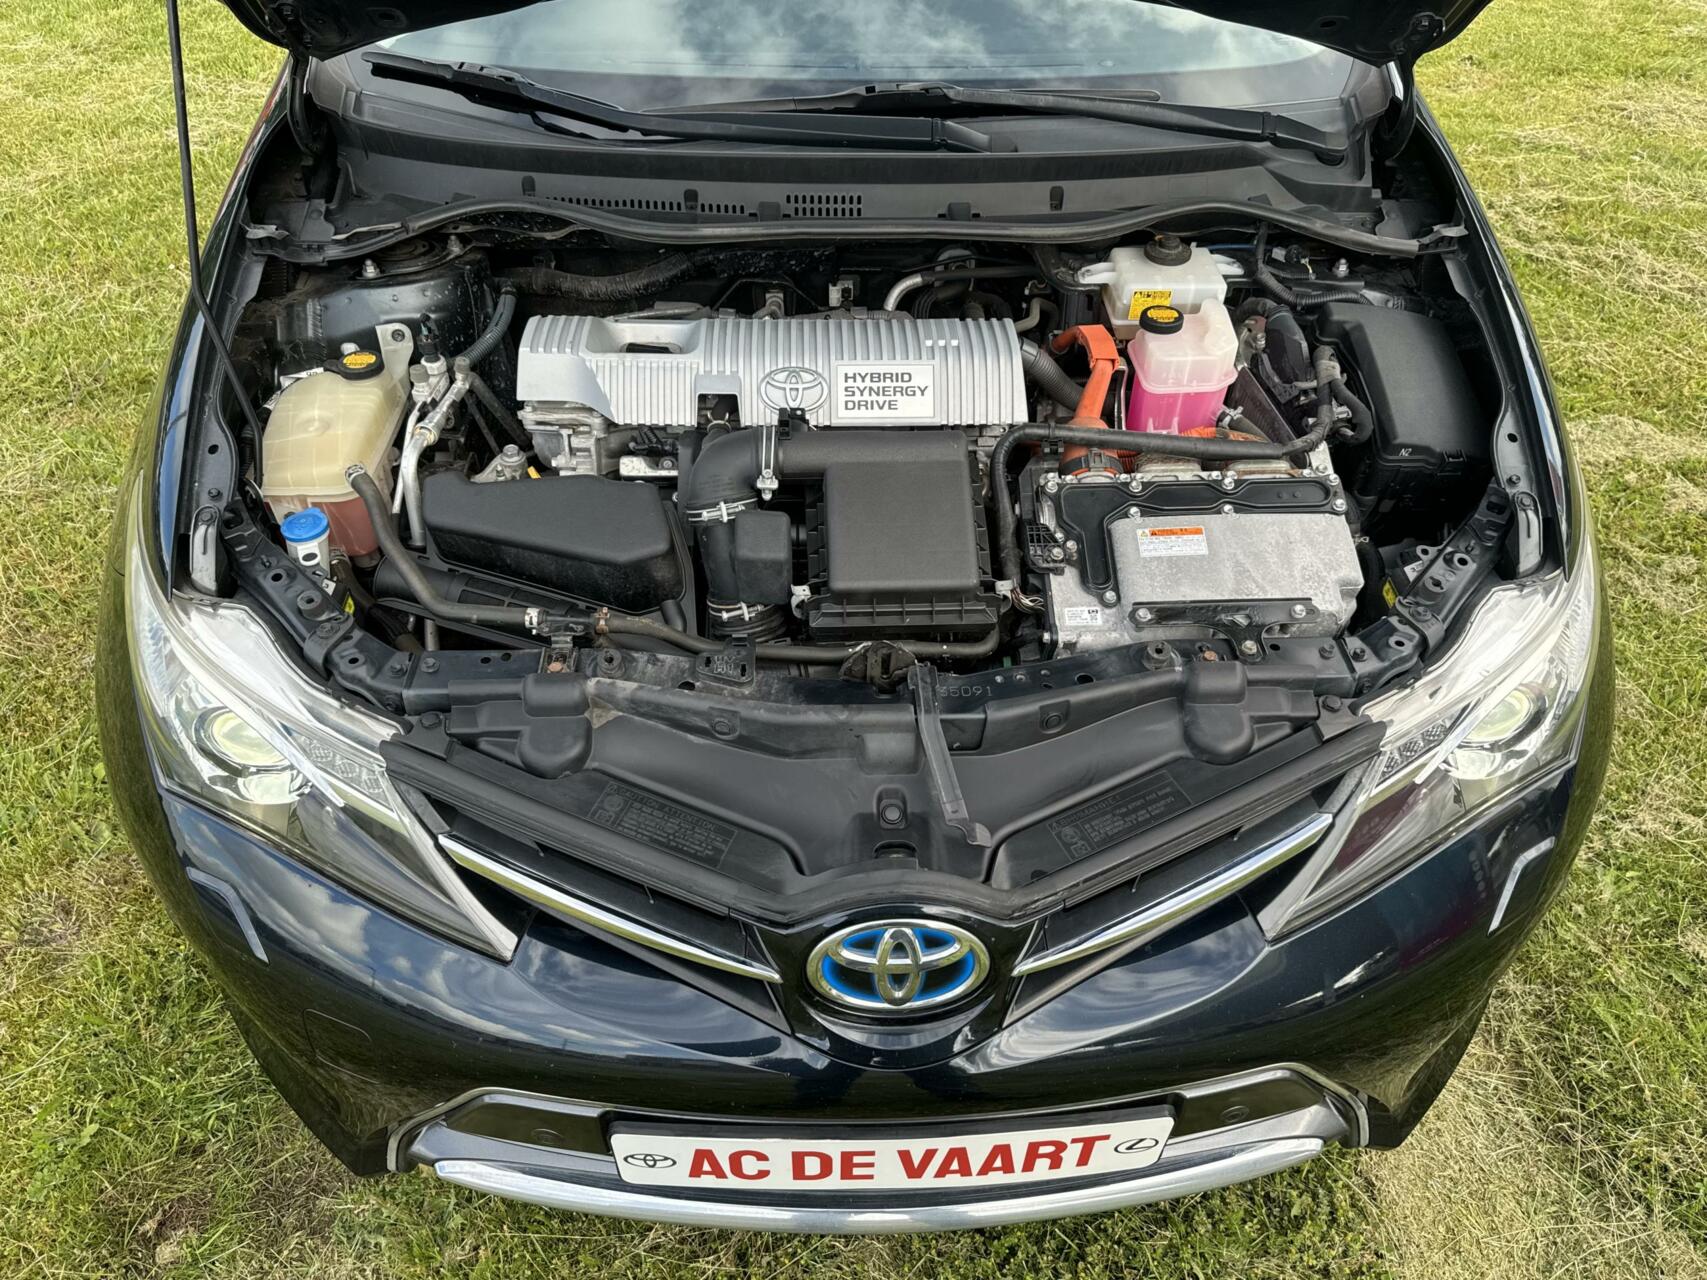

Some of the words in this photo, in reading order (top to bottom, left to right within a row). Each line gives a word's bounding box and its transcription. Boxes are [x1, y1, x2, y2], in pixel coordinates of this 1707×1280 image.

[844, 372, 912, 383] HYBRID
[844, 386, 928, 397] SYNERGY
[844, 400, 898, 411] DRIVE
[620, 788, 659, 809] CAUTION
[664, 806, 716, 831] ATTENTION
[688, 1148, 771, 1180] AC
[791, 1150, 876, 1181] DE
[896, 1135, 1111, 1180] VAART
